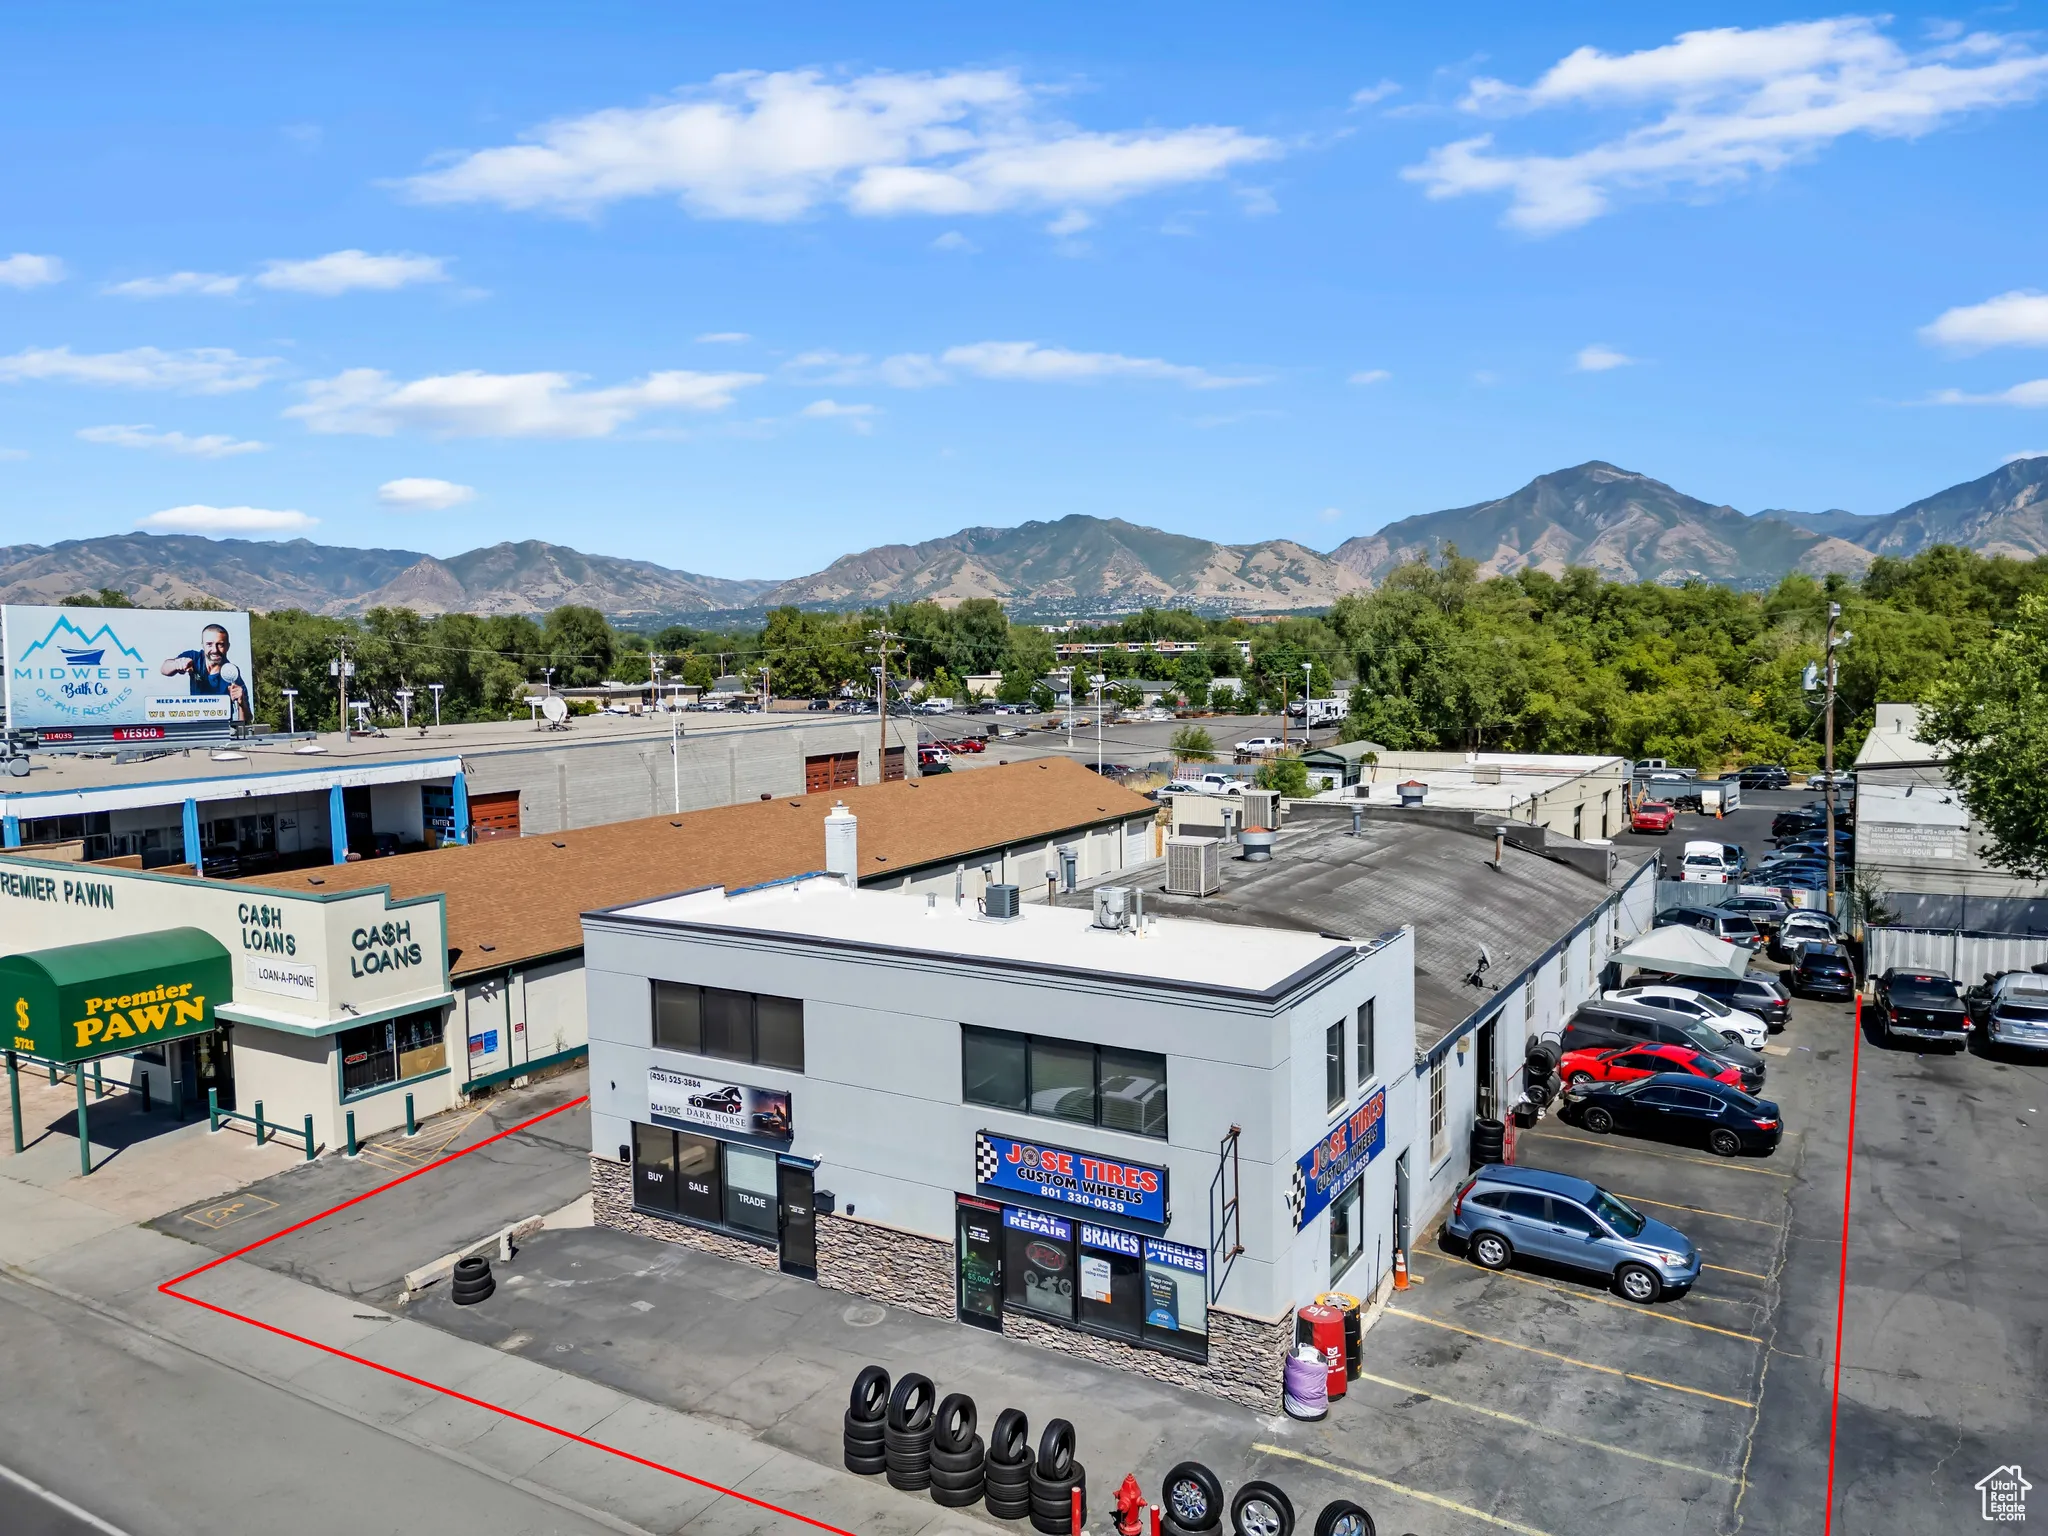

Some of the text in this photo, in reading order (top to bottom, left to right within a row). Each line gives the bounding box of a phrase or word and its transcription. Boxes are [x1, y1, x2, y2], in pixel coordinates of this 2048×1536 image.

[14, 668, 150, 680] MIDWEST
[36, 686, 132, 716] OF THE ROCKIES
[61, 682, 108, 698] Bath Co
[64, 880, 114, 909] PAWN
[242, 928, 296, 956] LOANS
[351, 943, 422, 978] LOANS
[259, 968, 314, 988] LOAN-A-PHONE
[85, 983, 193, 1015] Premier
[73, 996, 205, 1048] PAWN
[14, 1037, 35, 1050] 3721
[345, 1053, 366, 1063] OPEN
[650, 1072, 701, 1088] (435) 525-3884
[686, 1107, 746, 1127] DARK HORSE
[1350, 1092, 1384, 1143] TIRES
[1006, 1144, 1158, 1193] JOSE TIRES
[1316, 1124, 1377, 1194] CUSTOM WHEELS
[648, 1172, 664, 1183] BUY
[1017, 1168, 1143, 1205] CUSTOM WHEELS
[1330, 1152, 1370, 1199] 801 330-0639
[688, 1182, 709, 1194] SALE
[1041, 1186, 1124, 1213] 801 330-0639
[738, 1193, 766, 1208] TRADE
[1010, 1216, 1066, 1238] REPAIR
[1018, 1208, 1058, 1225] FLAT
[1082, 1224, 1139, 1254] BRAKES
[1027, 1244, 1064, 1268] OPEN
[1157, 1251, 1204, 1271] TIRES
[968, 1272, 991, 1284] $5,000
